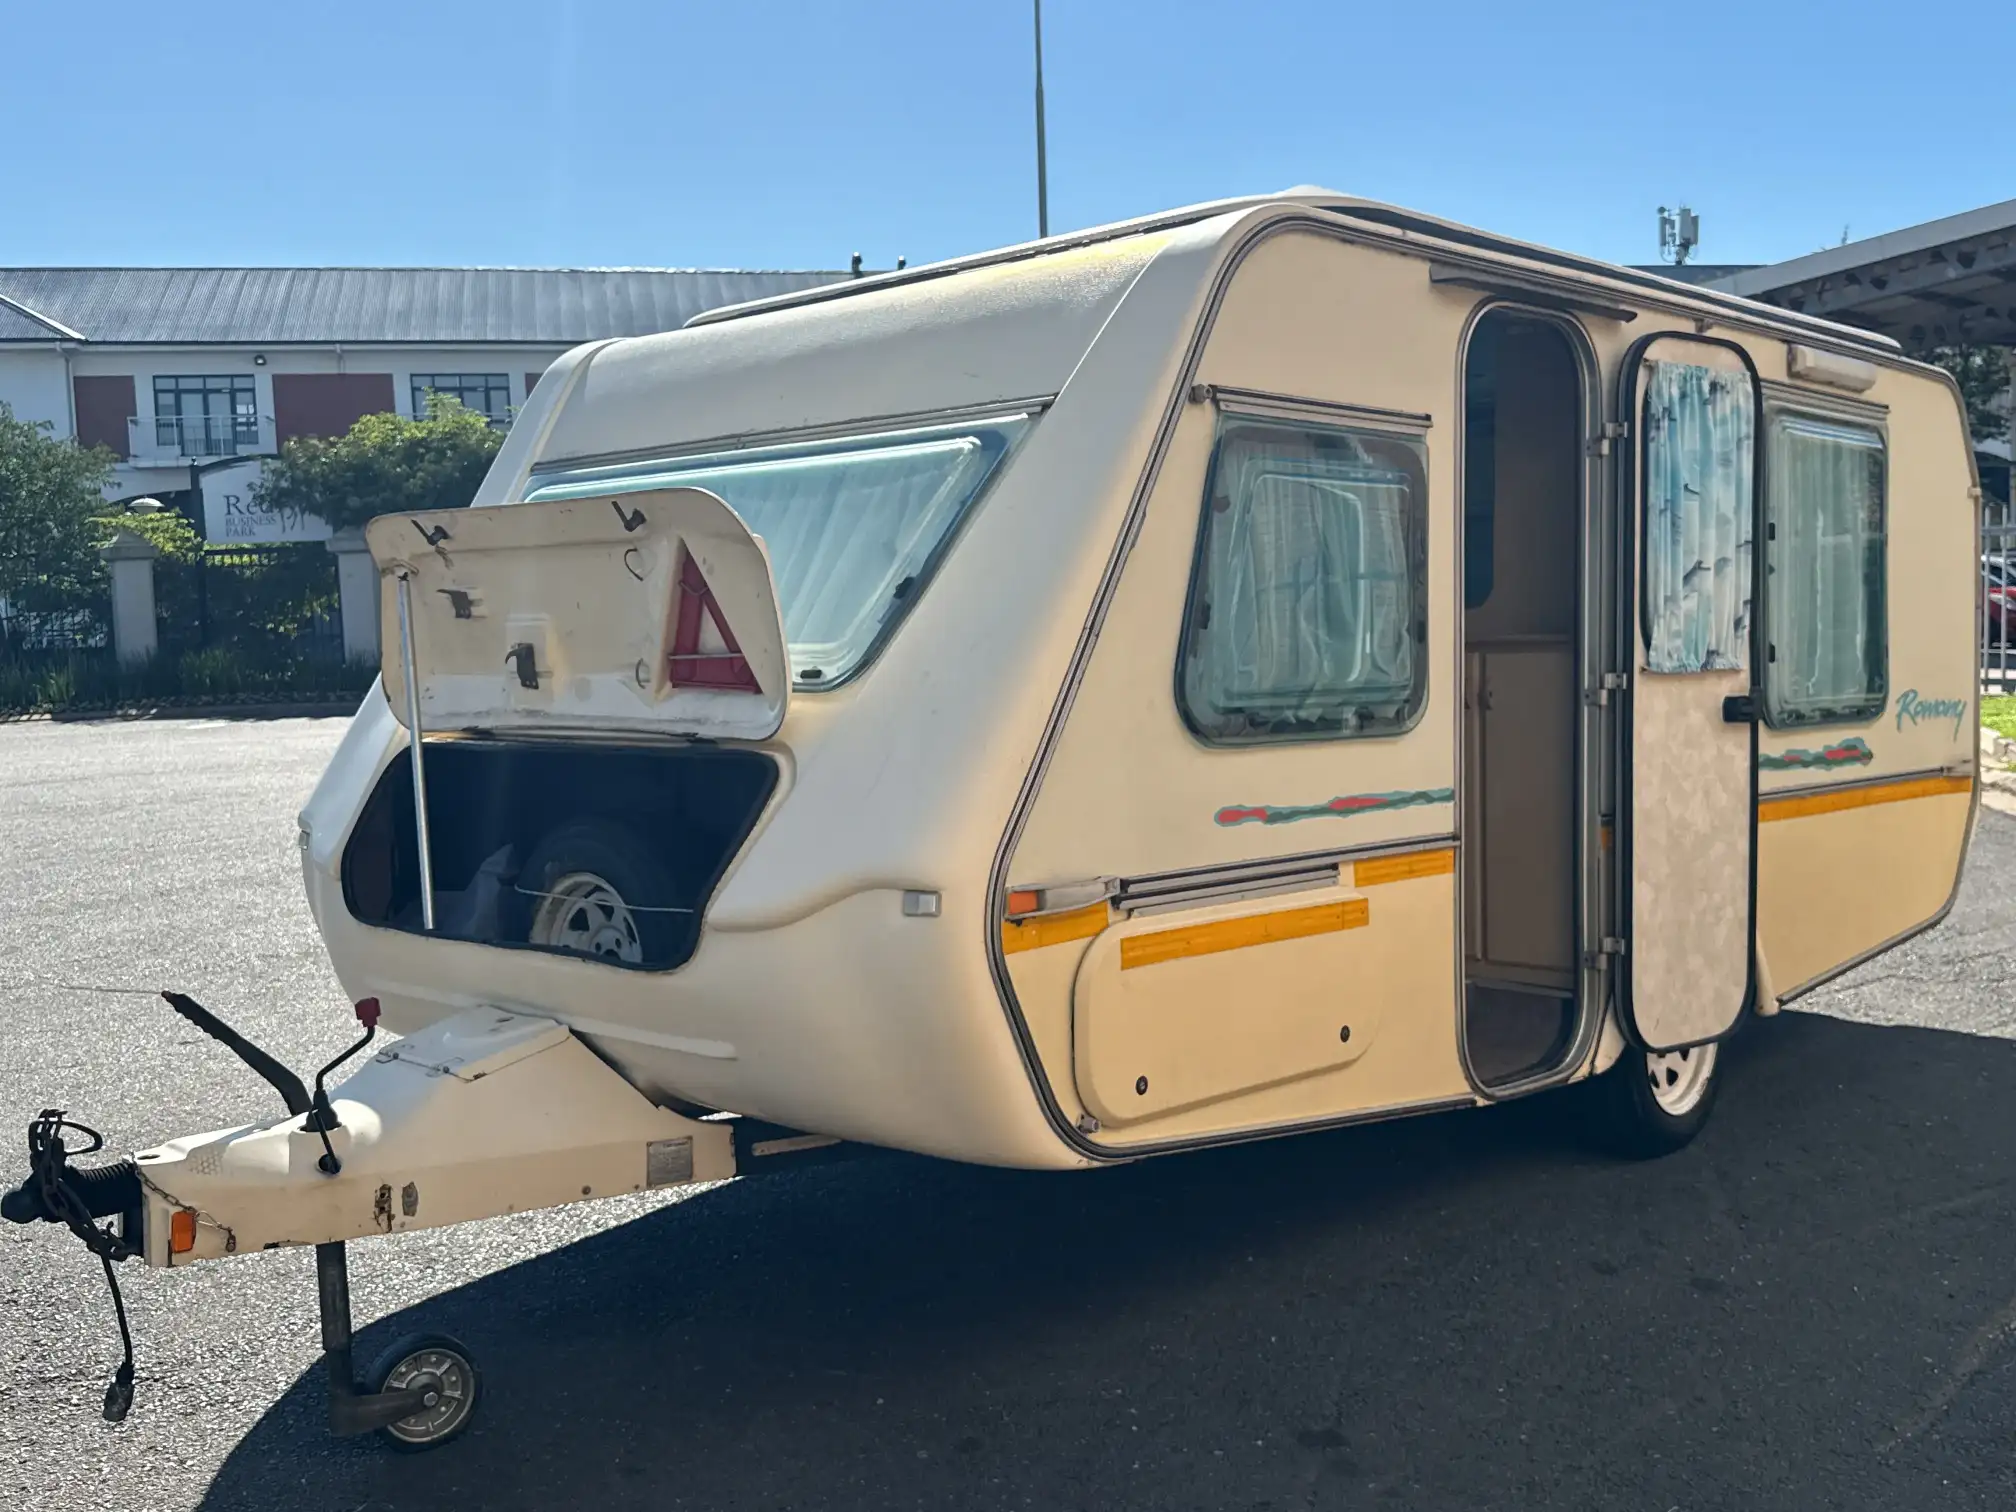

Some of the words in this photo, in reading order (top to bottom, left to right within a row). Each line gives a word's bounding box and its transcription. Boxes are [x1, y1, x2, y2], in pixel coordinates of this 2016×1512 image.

[225, 516, 276, 526] BUSINESS
[226, 526, 256, 537] PARK
[1895, 688, 1967, 743] Romany
